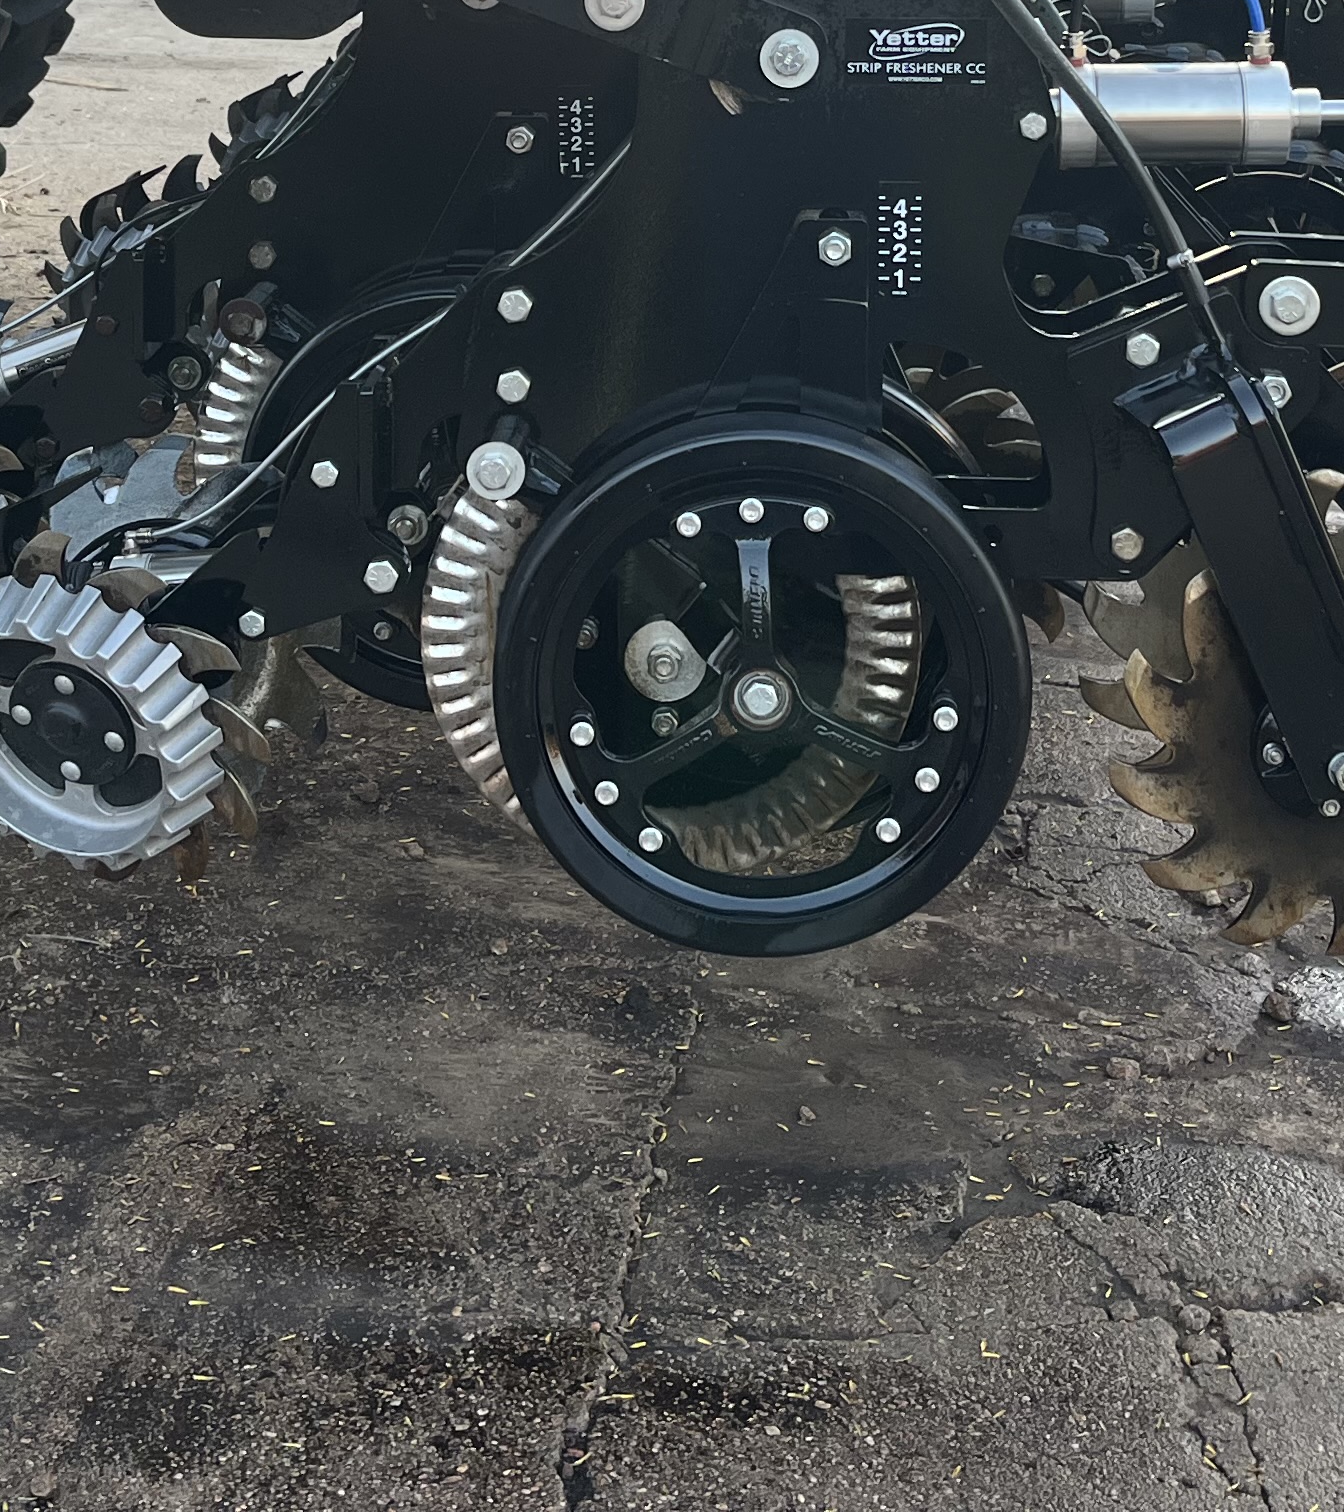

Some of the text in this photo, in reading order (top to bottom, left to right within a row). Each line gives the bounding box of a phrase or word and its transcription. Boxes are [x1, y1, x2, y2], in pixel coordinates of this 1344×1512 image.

[869, 29, 959, 47] Yetter
[847, 62, 986, 74] STRIP FRESHENER CC
[570, 99, 582, 115] 4
[570, 116, 582, 133] 3
[570, 135, 583, 152] 2
[571, 156, 580, 173] 1
[892, 198, 908, 218] 4
[892, 220, 908, 240] 3
[892, 242, 907, 263] 2
[893, 268, 904, 289] 1
